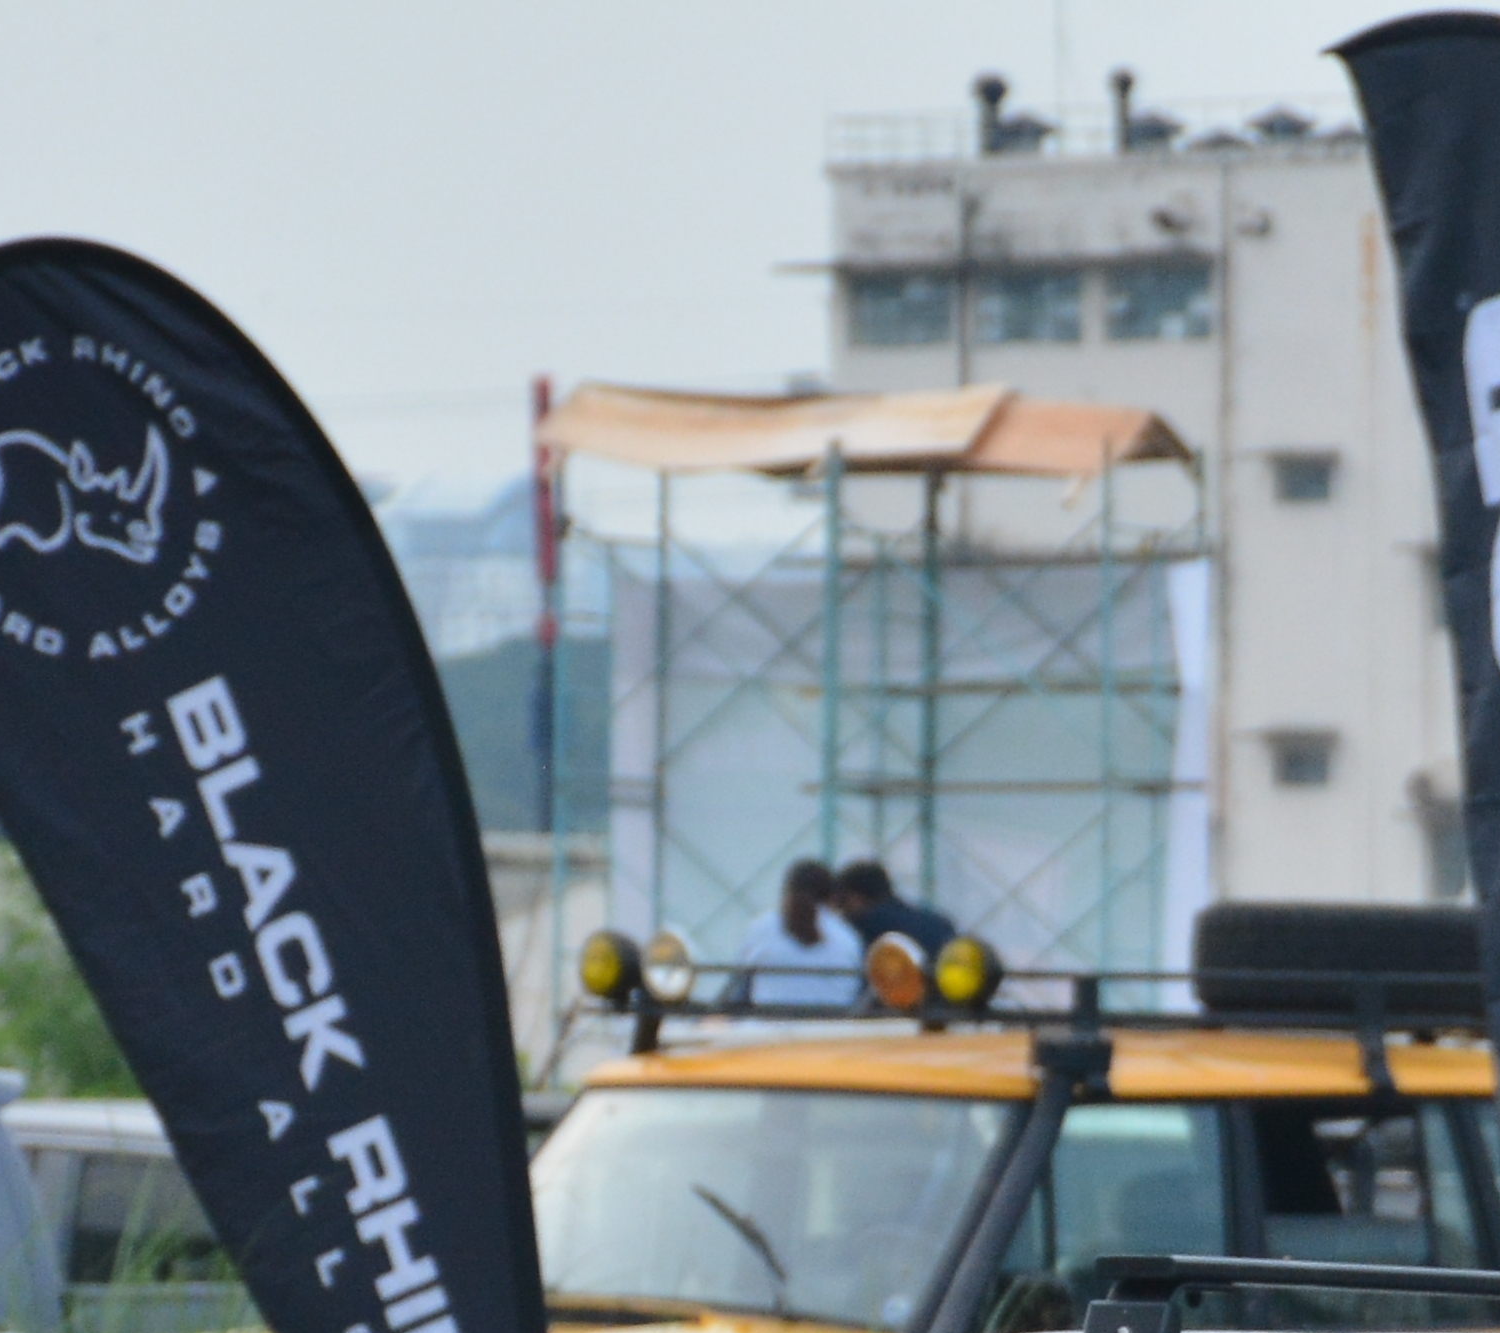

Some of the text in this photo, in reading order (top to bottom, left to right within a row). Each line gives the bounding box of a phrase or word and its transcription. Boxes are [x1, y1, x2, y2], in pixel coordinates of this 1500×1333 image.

[72, 337, 197, 439] RHINO
[89, 521, 221, 661] ALLOYS
[120, 711, 247, 999] HARD
[167, 675, 366, 1092] BLACK
